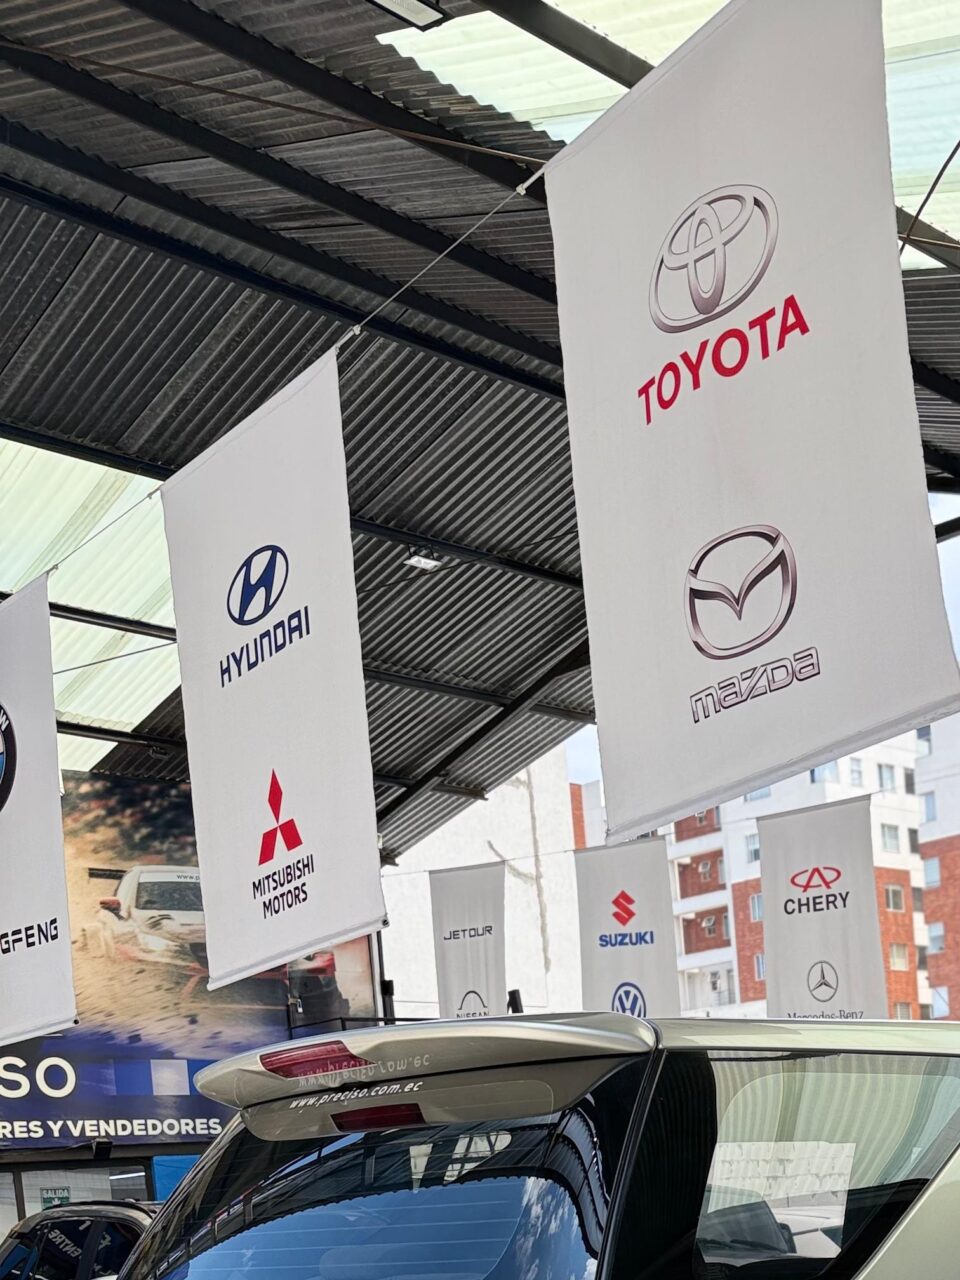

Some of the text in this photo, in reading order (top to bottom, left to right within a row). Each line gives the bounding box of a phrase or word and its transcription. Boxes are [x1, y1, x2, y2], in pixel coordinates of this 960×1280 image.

[637, 294, 810, 426] TOYOTA
[219, 605, 311, 688] HYUNDAI
[252, 854, 315, 900] MITSUBISHI
[262, 881, 308, 919] MOTORS
[783, 891, 851, 915] CHERY
[0, 917, 58, 955] GFENG
[443, 925, 493, 941] JETOUR
[599, 930, 654, 948] SUZUKI
[0, 1055, 76, 1098] SO
[289, 1081, 424, 1108] www.preciso.com.ec
[0, 1118, 223, 1138] RES Y VENDEDORES
[42, 1188, 70, 1199] SALIDA
